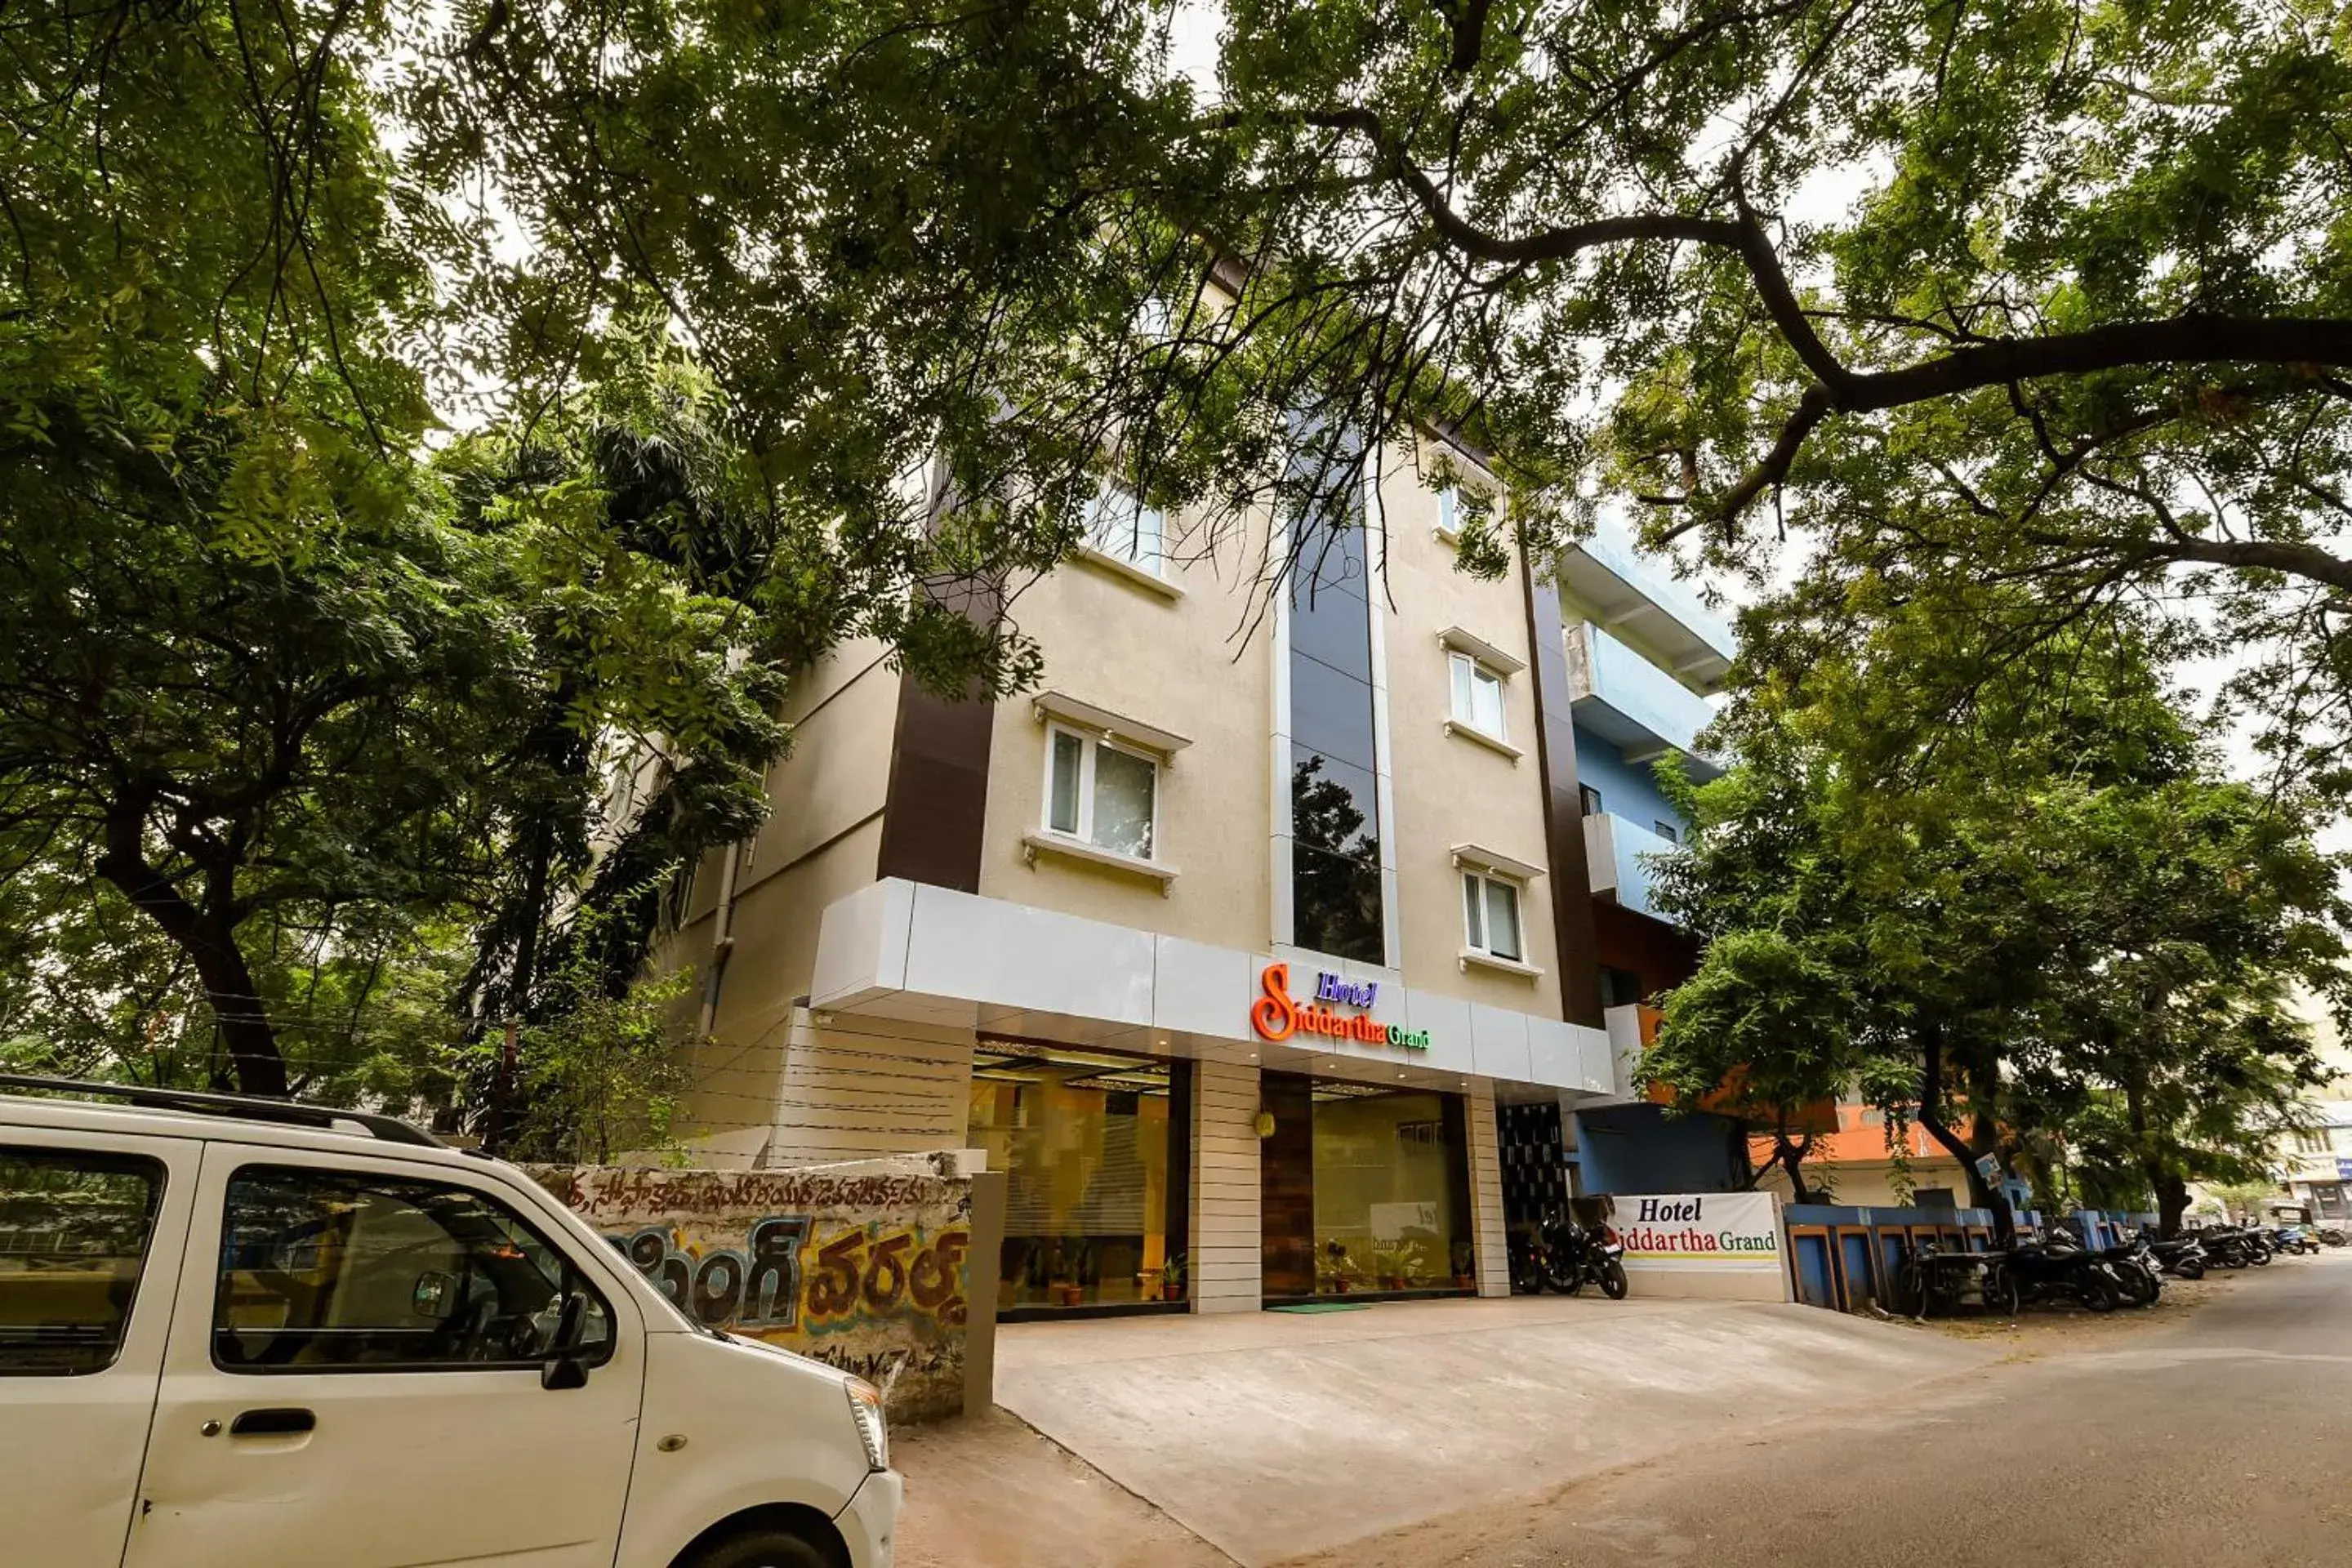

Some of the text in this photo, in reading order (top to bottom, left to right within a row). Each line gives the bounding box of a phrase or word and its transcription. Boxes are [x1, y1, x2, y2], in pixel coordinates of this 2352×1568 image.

[1316, 972, 1378, 1008] Hotel
[1251, 962, 1431, 1050] Siddartha Grand
[1638, 1197, 1703, 1222] Hotel
[1619, 1227, 1777, 1252] iddartha Grand
